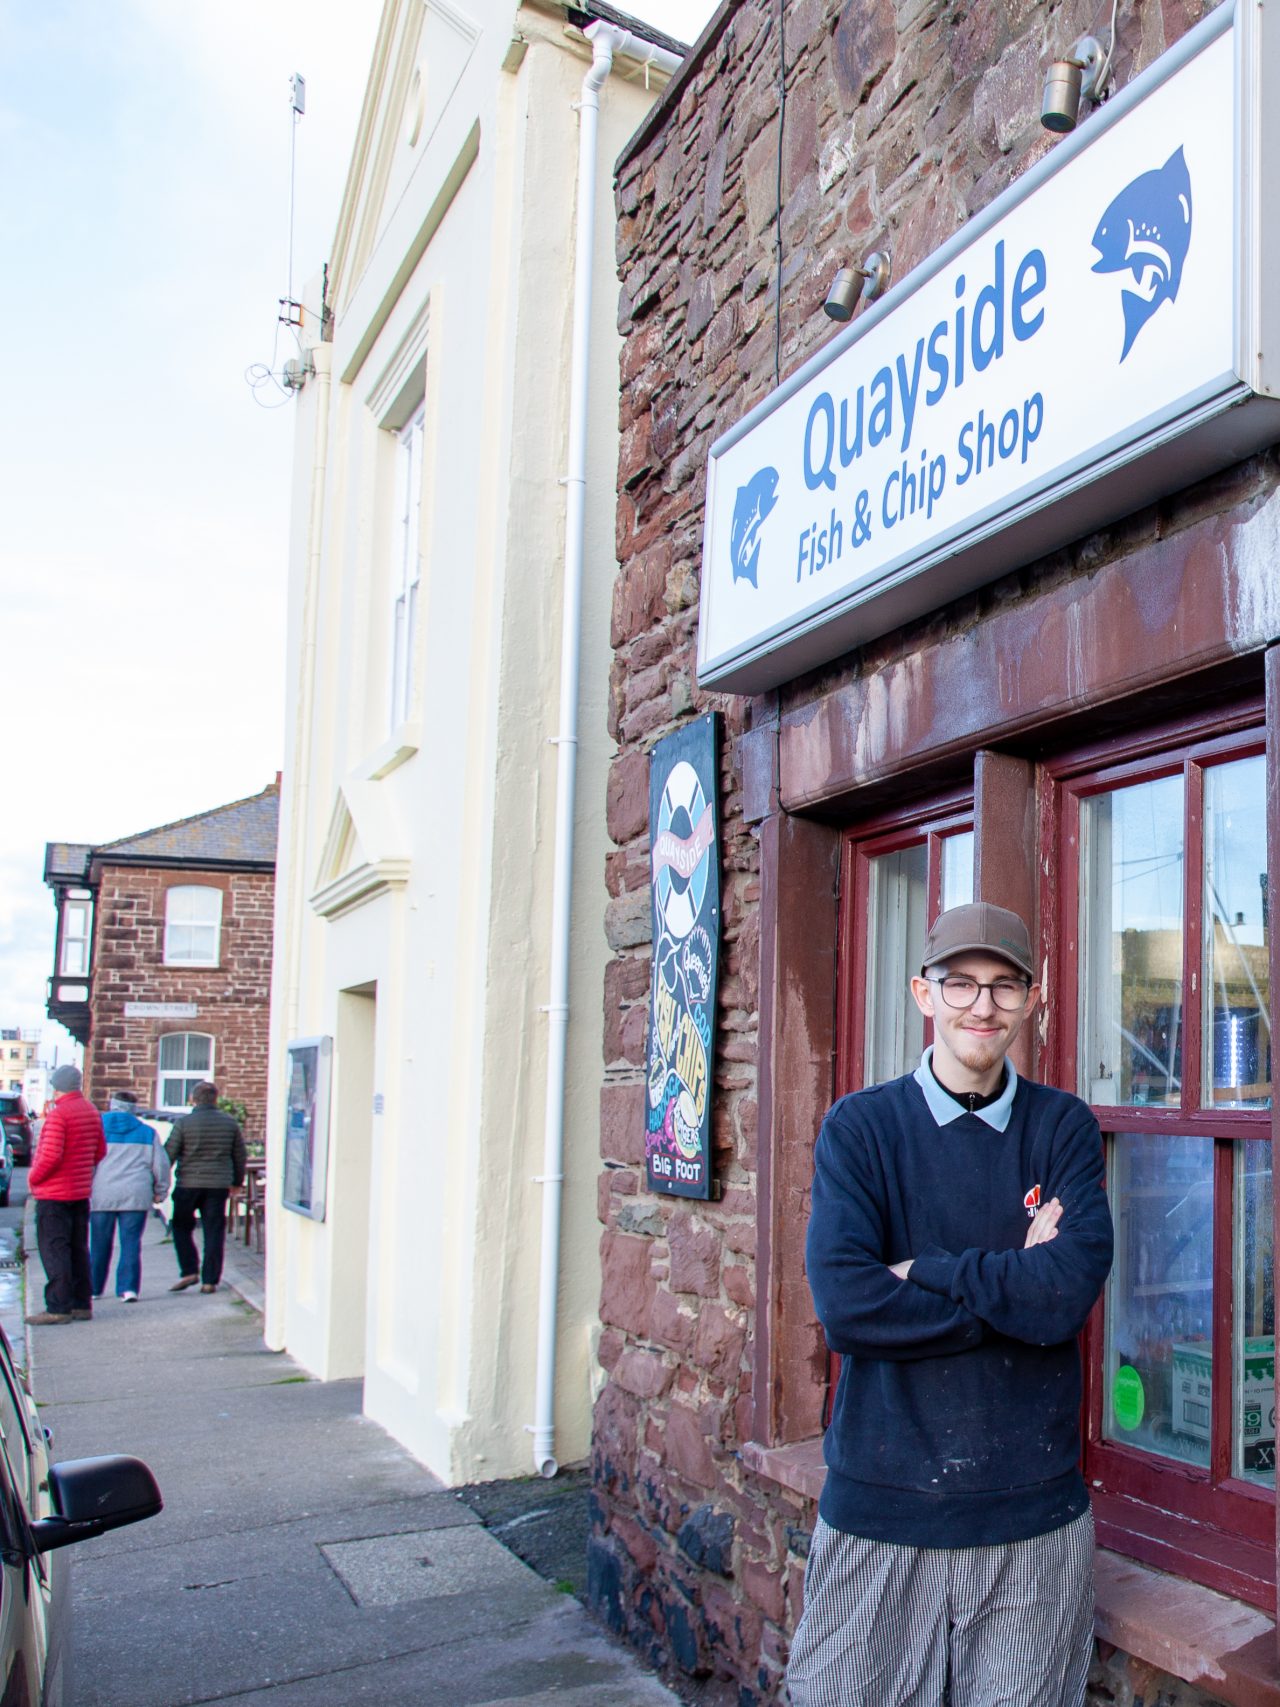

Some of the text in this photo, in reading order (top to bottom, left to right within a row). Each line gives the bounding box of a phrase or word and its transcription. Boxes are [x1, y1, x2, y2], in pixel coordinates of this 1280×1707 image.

[803, 239, 1047, 492] Quayside
[796, 391, 1045, 583] Fish & Chip Shop
[660, 835, 702, 873] QUAYSIDE
[164, 1004, 195, 1012] STREET
[694, 1003, 711, 1048] COD
[676, 1012, 705, 1117] CHIPS
[653, 1154, 701, 1181] BIG FOOT
